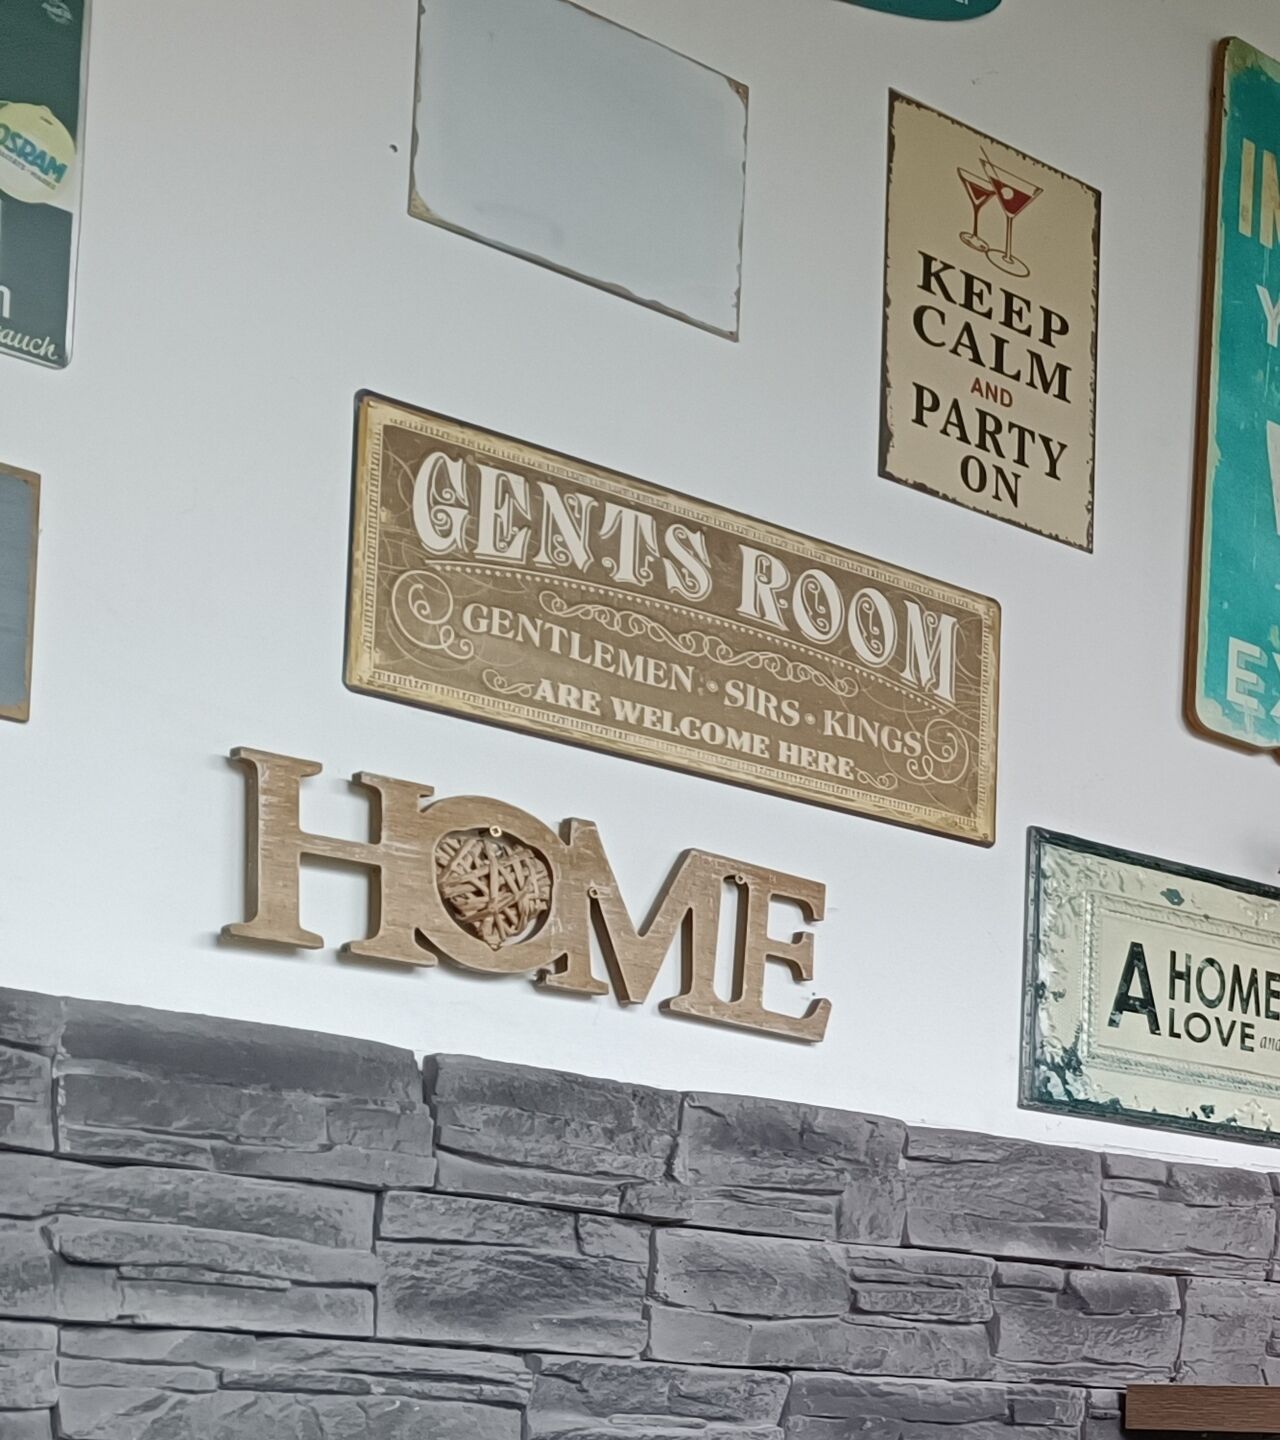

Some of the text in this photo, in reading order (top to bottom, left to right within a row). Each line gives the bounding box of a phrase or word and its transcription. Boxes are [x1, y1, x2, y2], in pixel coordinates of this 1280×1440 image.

[0, 326, 58, 360] auch
[917, 249, 1070, 349] KEEP
[912, 304, 1072, 404] CALM
[970, 376, 1013, 408] AND
[911, 381, 1068, 481] PARTY
[960, 454, 1022, 508] ON
[412, 450, 959, 704] GENTS ROOM
[462, 601, 922, 758] GENTLEMEN SIRS KINGS
[534, 678, 856, 782] ARE WELCOME HERE
[219, 746, 833, 1043] HOME
[1107, 941, 1161, 1036] A
[1168, 949, 1280, 1020] HOME
[1168, 1007, 1256, 1053] LOVE
